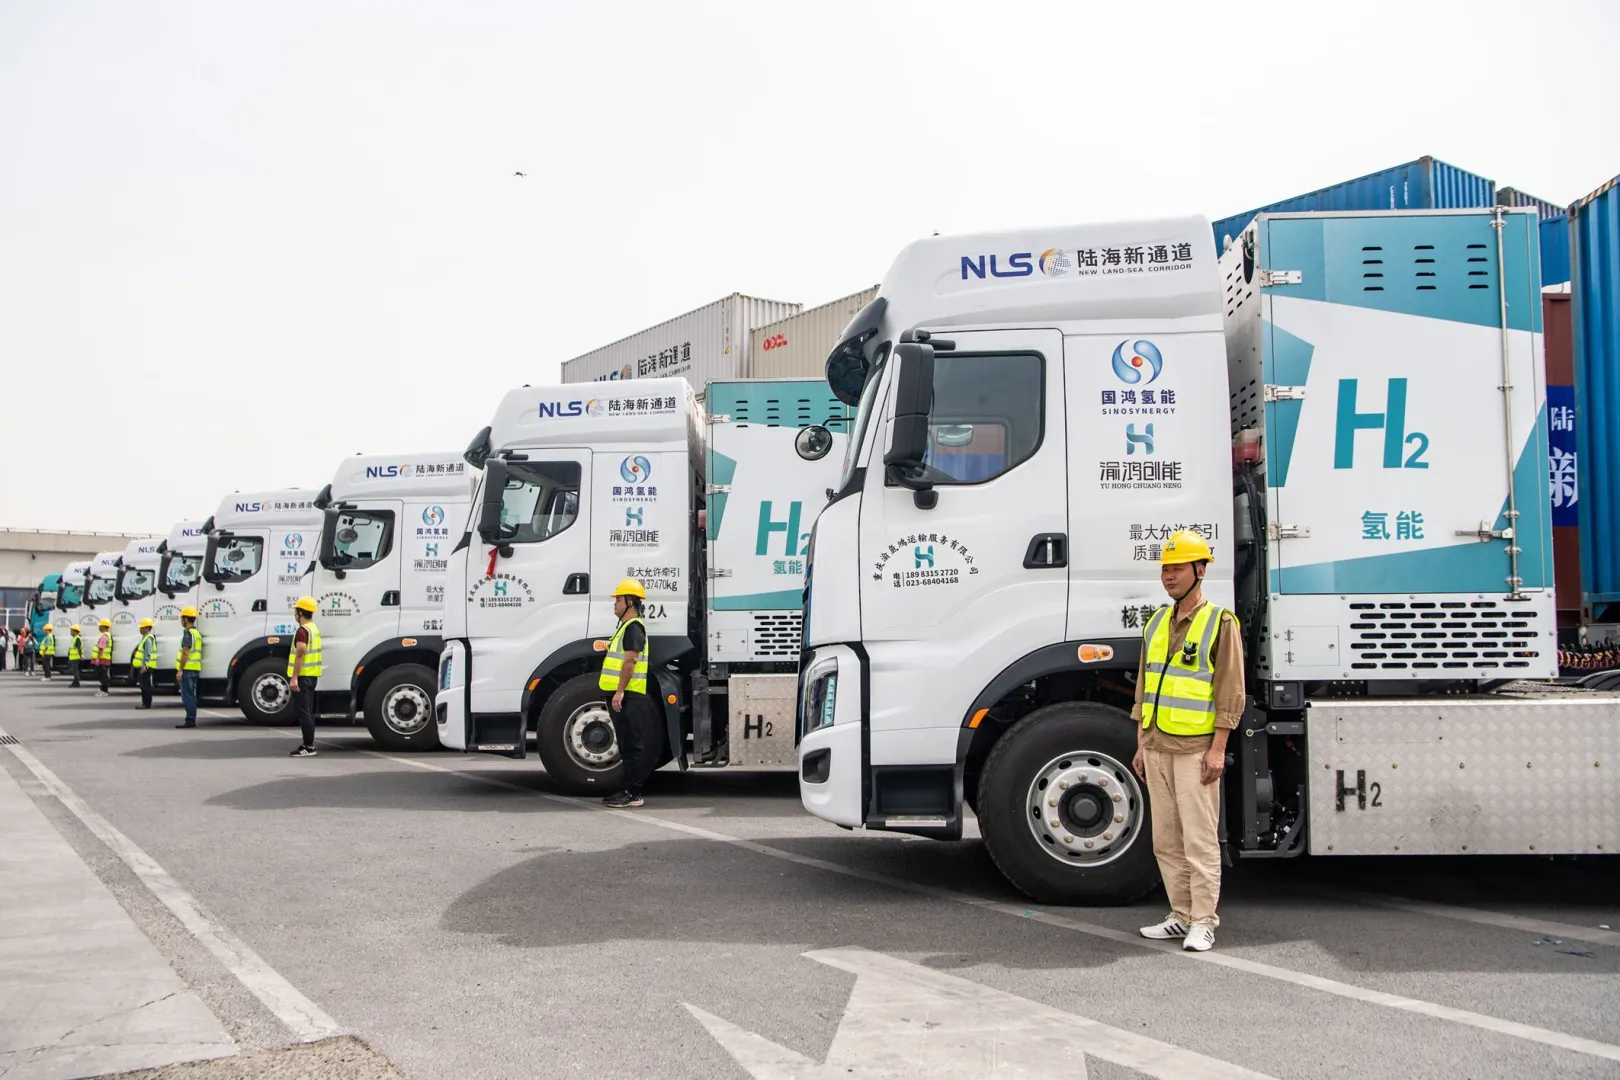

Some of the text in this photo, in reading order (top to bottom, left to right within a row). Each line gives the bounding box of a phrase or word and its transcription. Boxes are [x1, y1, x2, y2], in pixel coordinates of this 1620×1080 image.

[1077, 242, 1193, 268] 陆海新通道
[961, 252, 1034, 280] NLS
[1148, 263, 1192, 273] CORRIDOR
[608, 396, 676, 411] 陆海新通道
[1101, 389, 1176, 405] 国鸿氢能
[539, 400, 582, 418] NLS
[1101, 407, 1175, 415] SINOSYNERGY
[1334, 378, 1429, 469] H2
[366, 466, 398, 478] NLS
[415, 462, 464, 474] 陆海新通道
[1100, 461, 1181, 481] 渝鸿创能
[612, 486, 657, 496] 国鸿氢能
[235, 503, 260, 512] NLS
[1361, 510, 1424, 541] 氢能
[626, 567, 680, 578] 最大允许牵引
[773, 560, 803, 575] 氢能
[905, 576, 959, 587] 023-68404168
[744, 714, 773, 739] H2
[1336, 769, 1382, 812] H2
